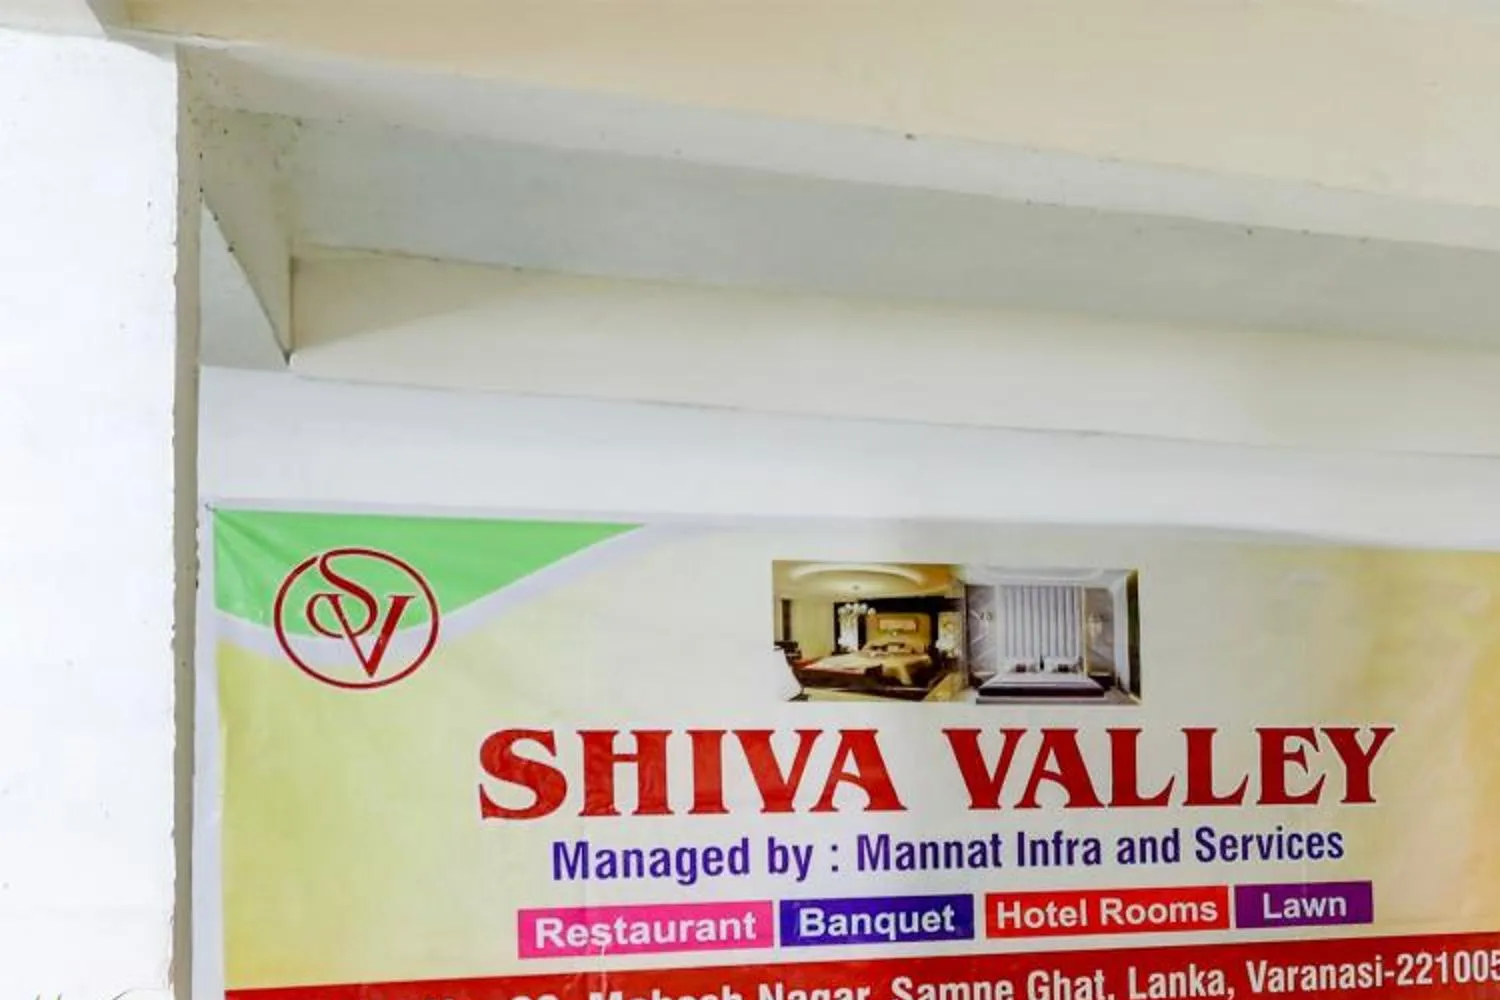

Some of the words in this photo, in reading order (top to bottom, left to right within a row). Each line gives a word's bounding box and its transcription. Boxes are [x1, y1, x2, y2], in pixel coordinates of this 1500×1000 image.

[479, 728, 907, 820] SHIVA
[942, 726, 1396, 810] VALLEY
[552, 837, 750, 885] Managed
[767, 836, 813, 880] by
[857, 831, 1002, 872] Mannat
[1016, 830, 1101, 867] Infra
[1116, 827, 1181, 863] and
[1194, 825, 1345, 862] Services
[799, 902, 955, 939] Banquet
[997, 898, 1088, 928] Hotel
[1099, 896, 1219, 926] Rooms
[1262, 891, 1348, 921] Lawn
[534, 910, 757, 950] Restaurant
